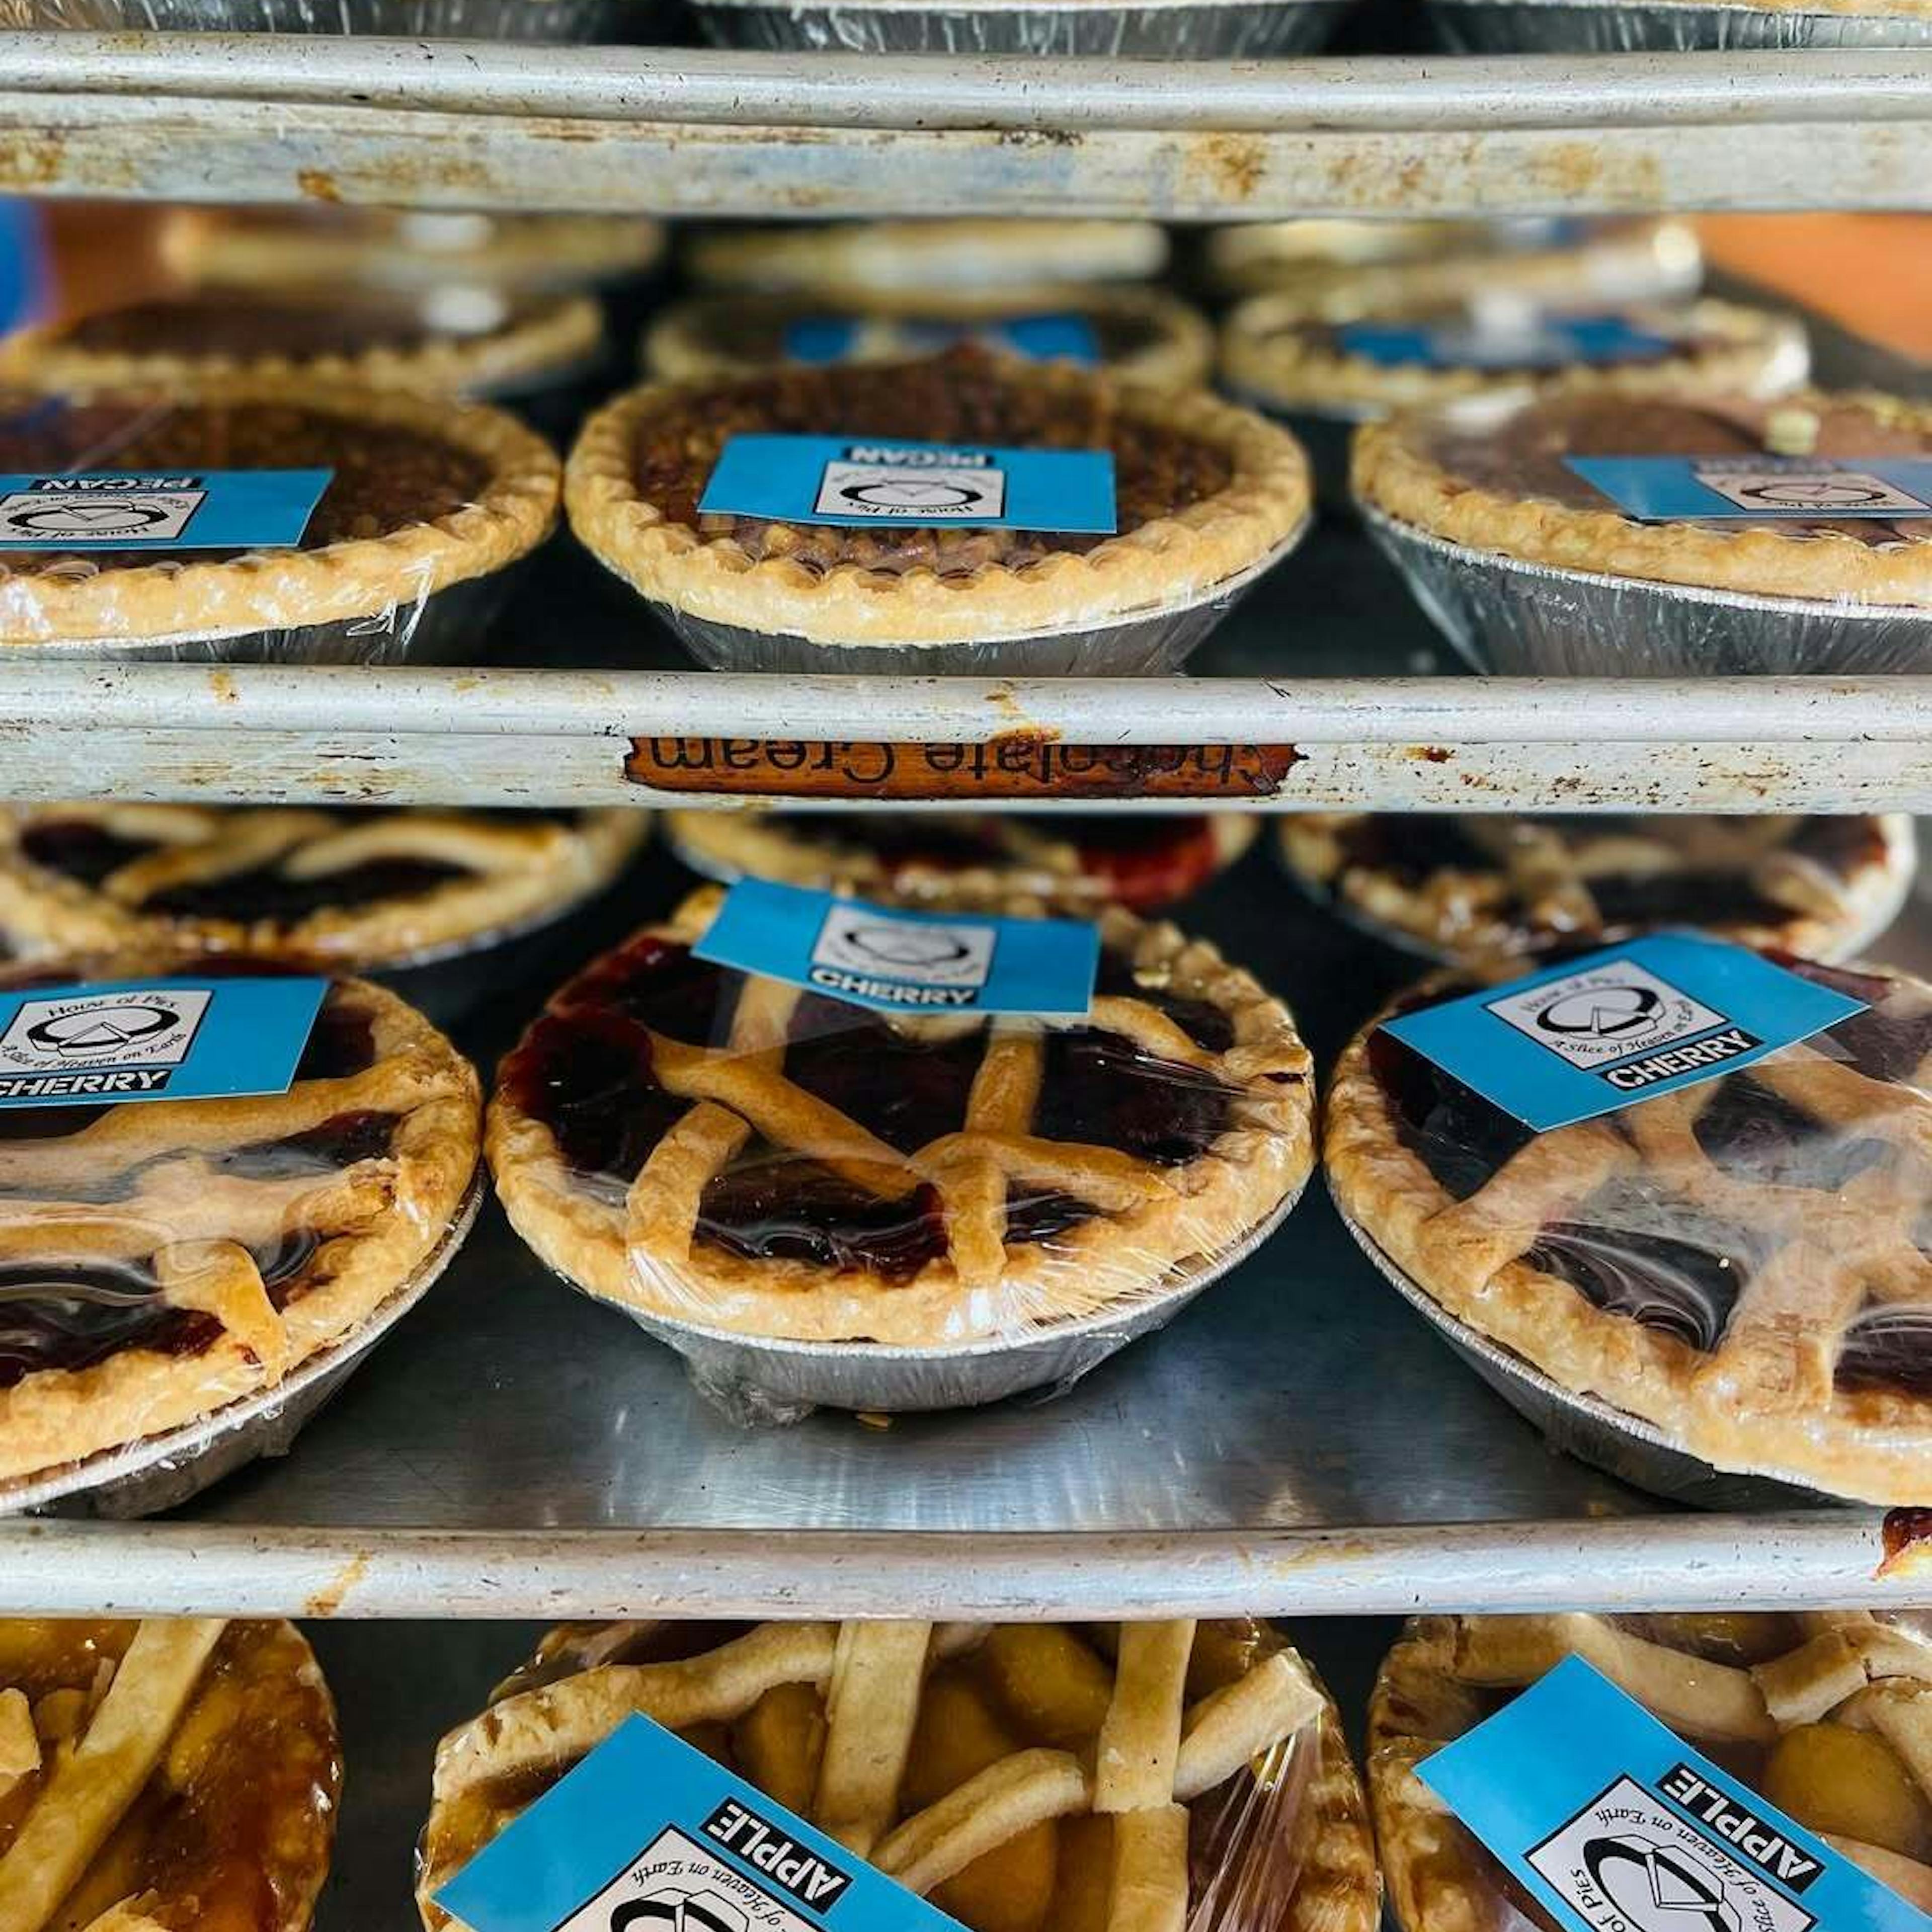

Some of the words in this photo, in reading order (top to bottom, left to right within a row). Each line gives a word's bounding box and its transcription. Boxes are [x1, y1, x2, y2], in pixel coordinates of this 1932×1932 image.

[42, 478, 194, 490] PECAN
[652, 738, 895, 783] Cream
[811, 968, 975, 1003] CHERRY
[1607, 1029, 1753, 1088] CHERRY
[1596, 1808, 1646, 1827] Earth
[1651, 1817, 1673, 1830] on
[1663, 1768, 1817, 1880] APPLE
[707, 1803, 845, 1901] APPLE
[1677, 1829, 1741, 1877] Heaven
[631, 1860, 683, 1887] Earth
[688, 1862, 709, 1875] on
[711, 1870, 769, 1911] Heaven
[1730, 1881, 1760, 1896] of
[755, 1910, 785, 1925] of
[1597, 1914, 1626, 1932] of
